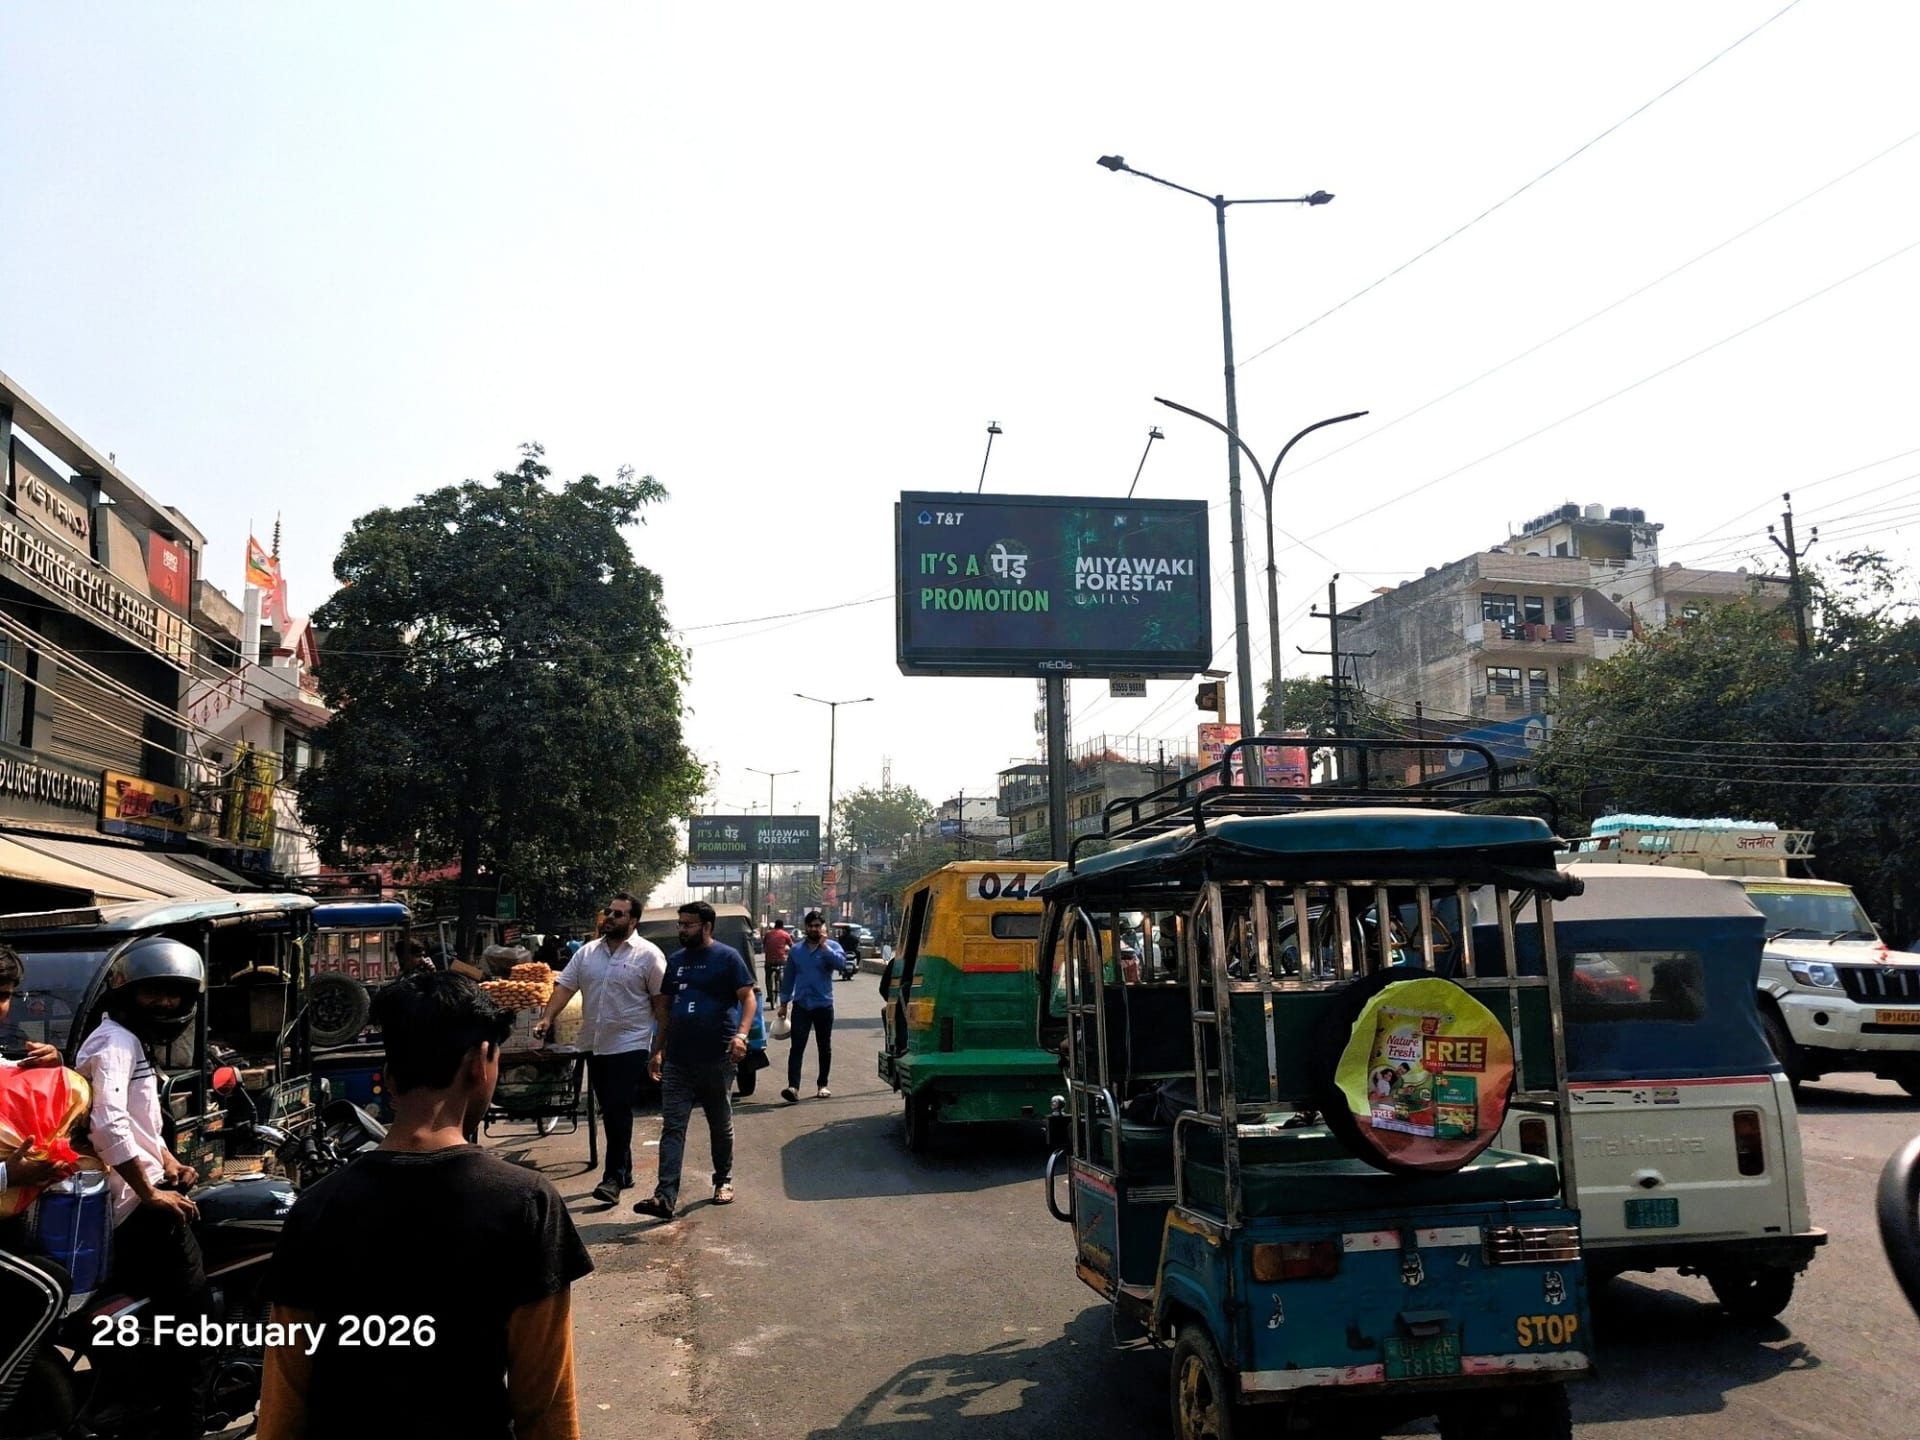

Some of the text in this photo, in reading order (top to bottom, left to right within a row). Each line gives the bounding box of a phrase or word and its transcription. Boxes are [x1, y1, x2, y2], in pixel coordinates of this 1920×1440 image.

[936, 512, 964, 526] T&T
[921, 544, 1028, 585] IT'S A पेड़
[1075, 557, 1194, 576] MIYAWAKI
[24, 533, 76, 592] DURGA
[80, 568, 116, 617] CYCLE
[119, 590, 154, 638] STORE
[1075, 573, 1173, 592] FOREST AT
[921, 587, 1049, 612] PROMOTION
[40, 767, 68, 801] CYCLE
[71, 776, 100, 809] STORE
[715, 830, 721, 838] A
[758, 829, 809, 837] MIYAWAKI
[758, 836, 791, 844] FOREST
[1736, 833, 1776, 850] अनमोल
[698, 842, 747, 851] PROMOTION
[1386, 1034, 1419, 1047] Nature
[1388, 1046, 1415, 1059] Fresh
[1425, 1040, 1483, 1063] FREE
[1372, 1109, 1393, 1119] FREE
[1516, 1314, 1578, 1348] STOP
